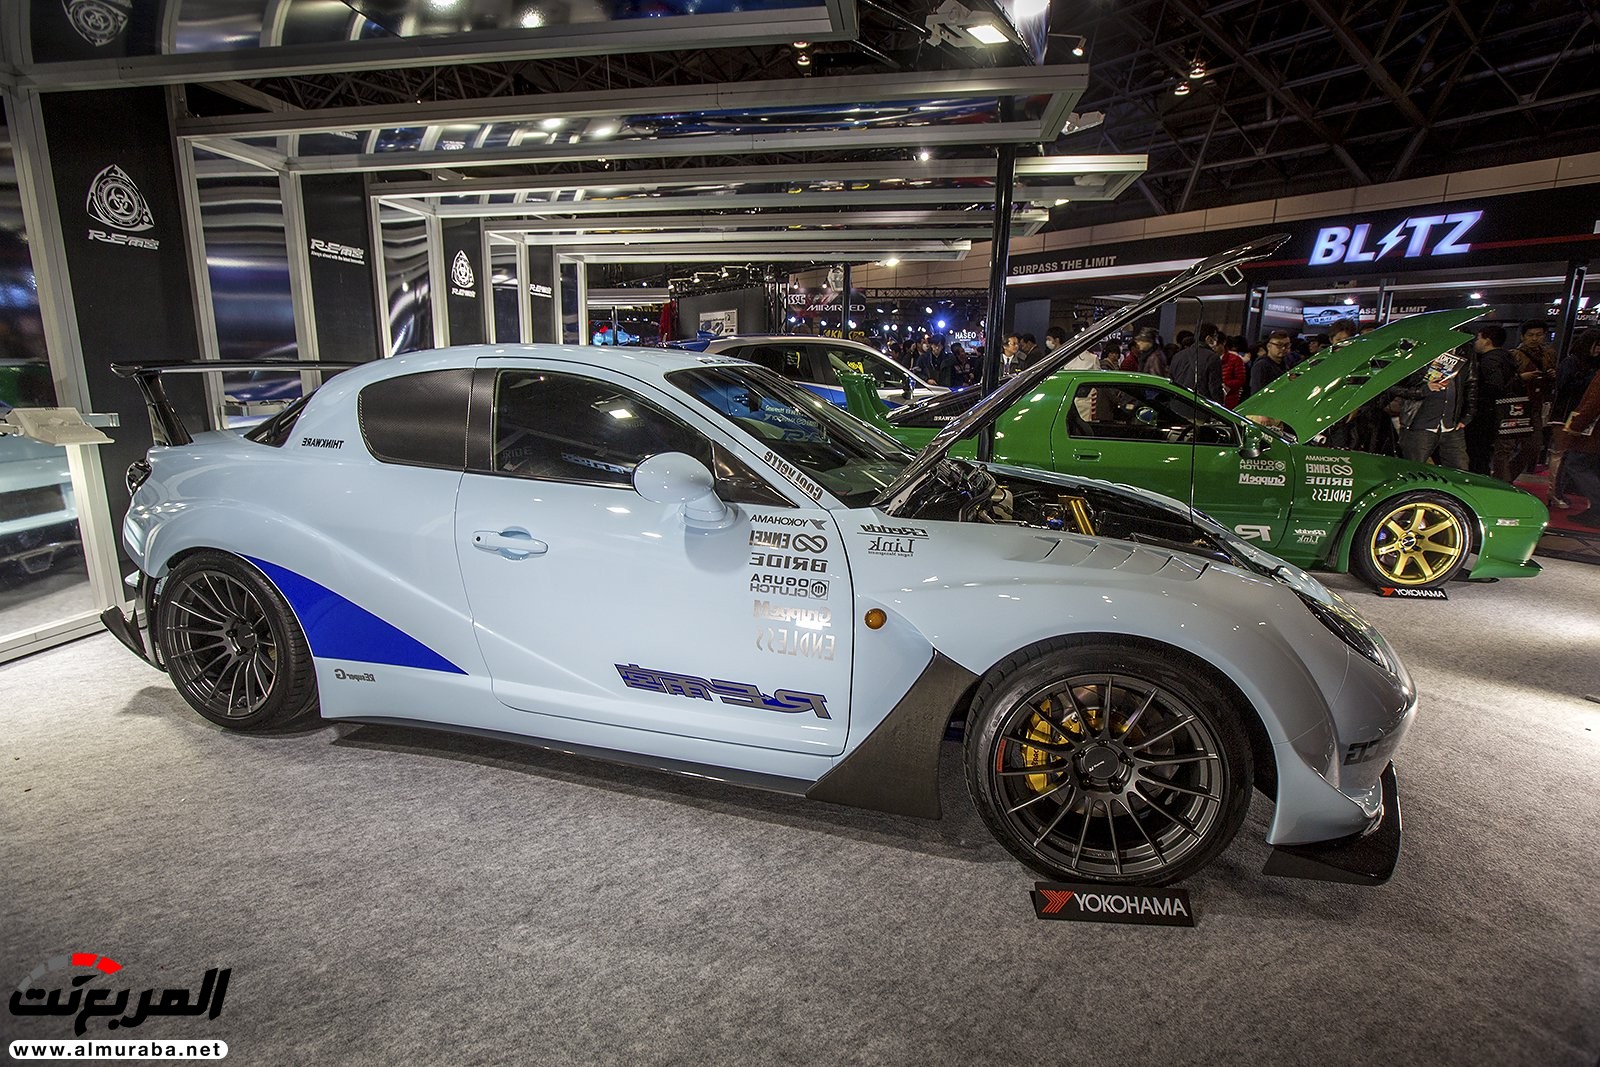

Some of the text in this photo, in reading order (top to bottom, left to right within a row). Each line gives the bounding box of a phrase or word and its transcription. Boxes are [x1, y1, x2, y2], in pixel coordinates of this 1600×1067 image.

[1308, 210, 1484, 266] BLITZ
[1012, 256, 1117, 275] SURPASS THE LIMIT
[1400, 306, 1427, 314] LIMIT
[1394, 588, 1446, 598] YOKOHAMA
[1074, 893, 1188, 917] YOKOHAMA
